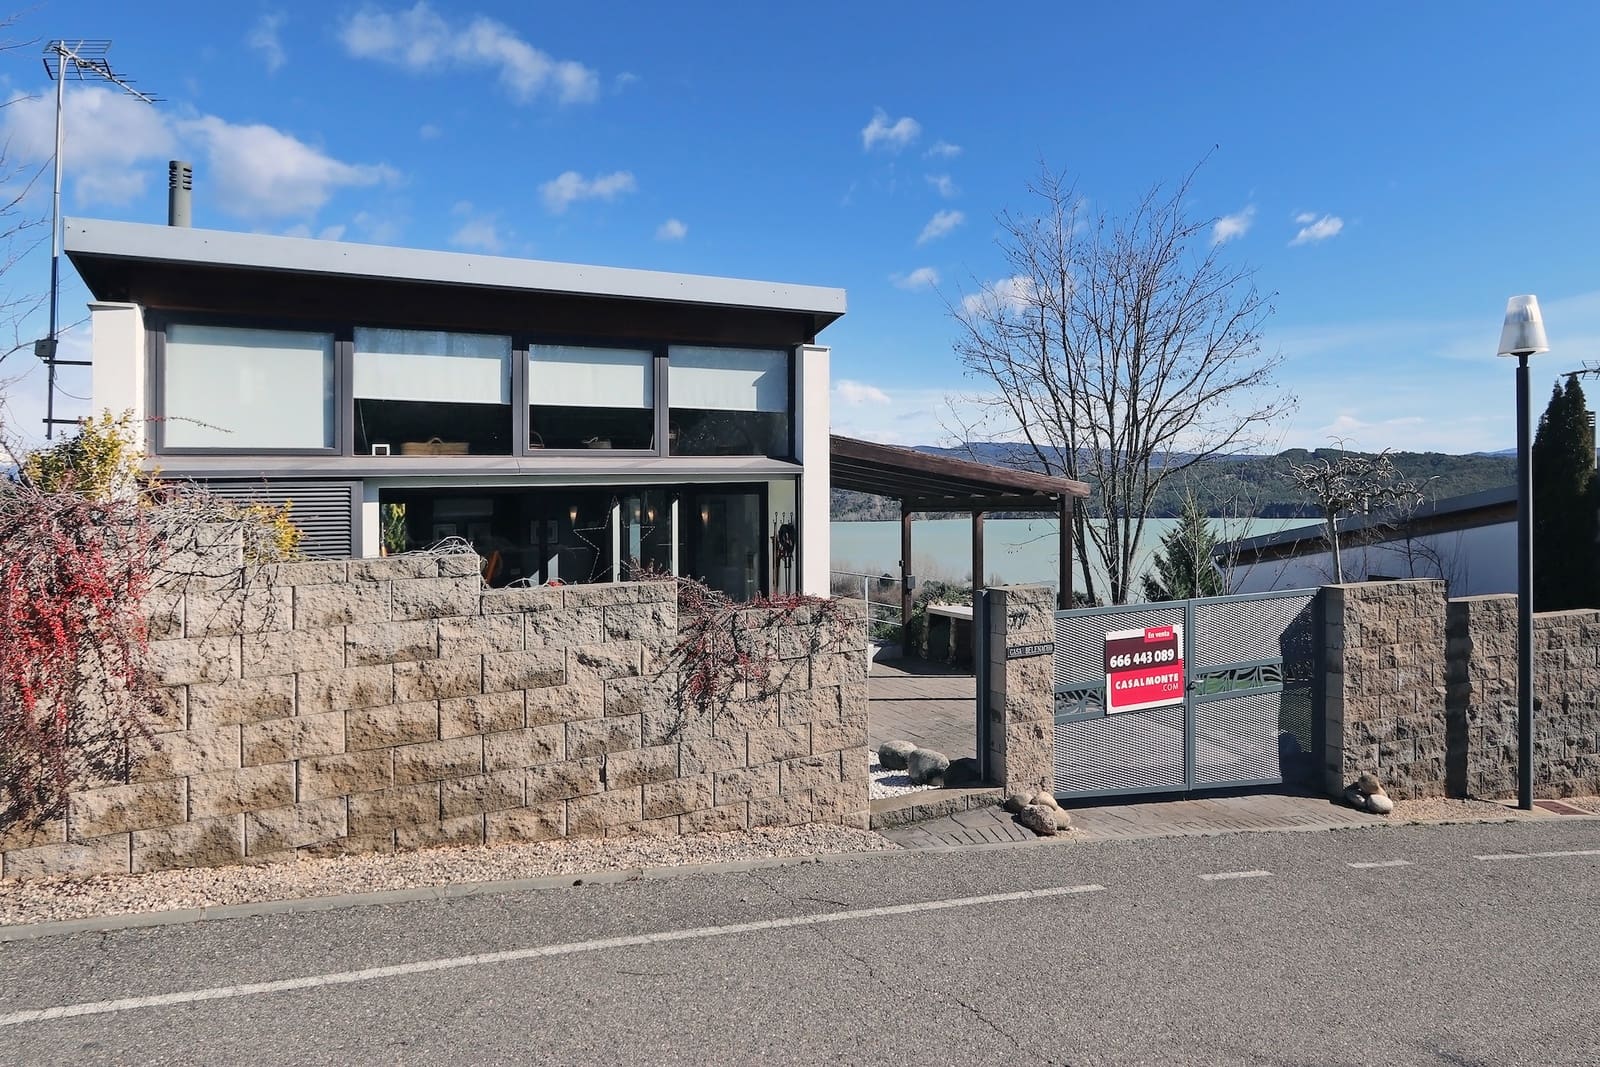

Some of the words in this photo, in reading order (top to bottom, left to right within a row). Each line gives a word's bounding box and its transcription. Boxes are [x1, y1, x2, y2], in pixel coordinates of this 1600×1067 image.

[1156, 630, 1170, 638] venta
[1109, 653, 1131, 668] 666
[1133, 651, 1153, 665] 443
[1154, 648, 1175, 662] 089
[1115, 673, 1179, 690] CASALMONTE
[1161, 682, 1179, 692] .COM
